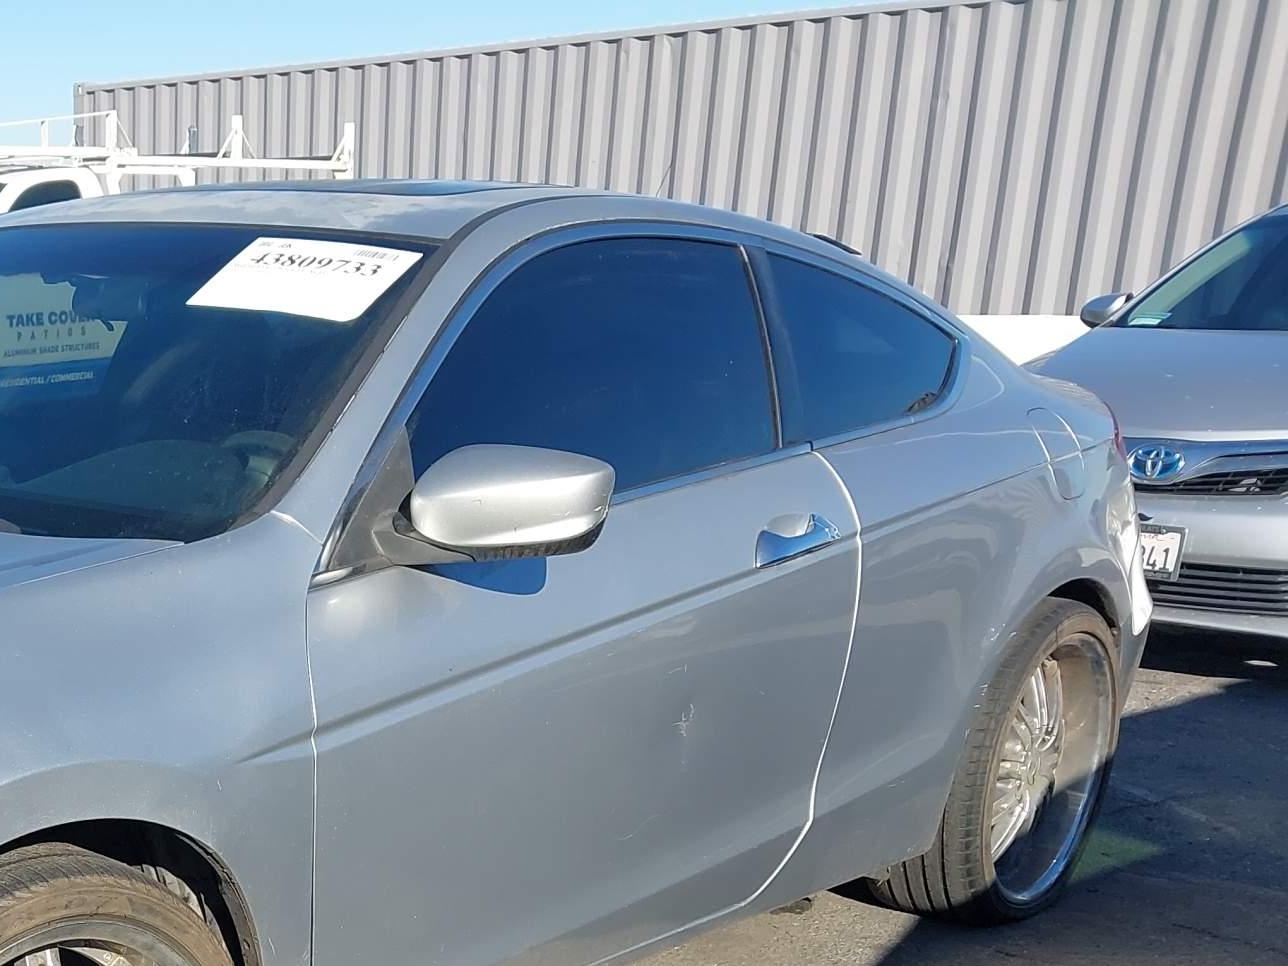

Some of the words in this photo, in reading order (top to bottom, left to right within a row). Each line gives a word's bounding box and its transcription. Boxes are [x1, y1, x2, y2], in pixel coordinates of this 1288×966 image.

[250, 251, 383, 277] 43809733
[6, 312, 45, 328] TAKE
[17, 326, 87, 342] PATIOS
[61, 342, 100, 353] STRUCTURES
